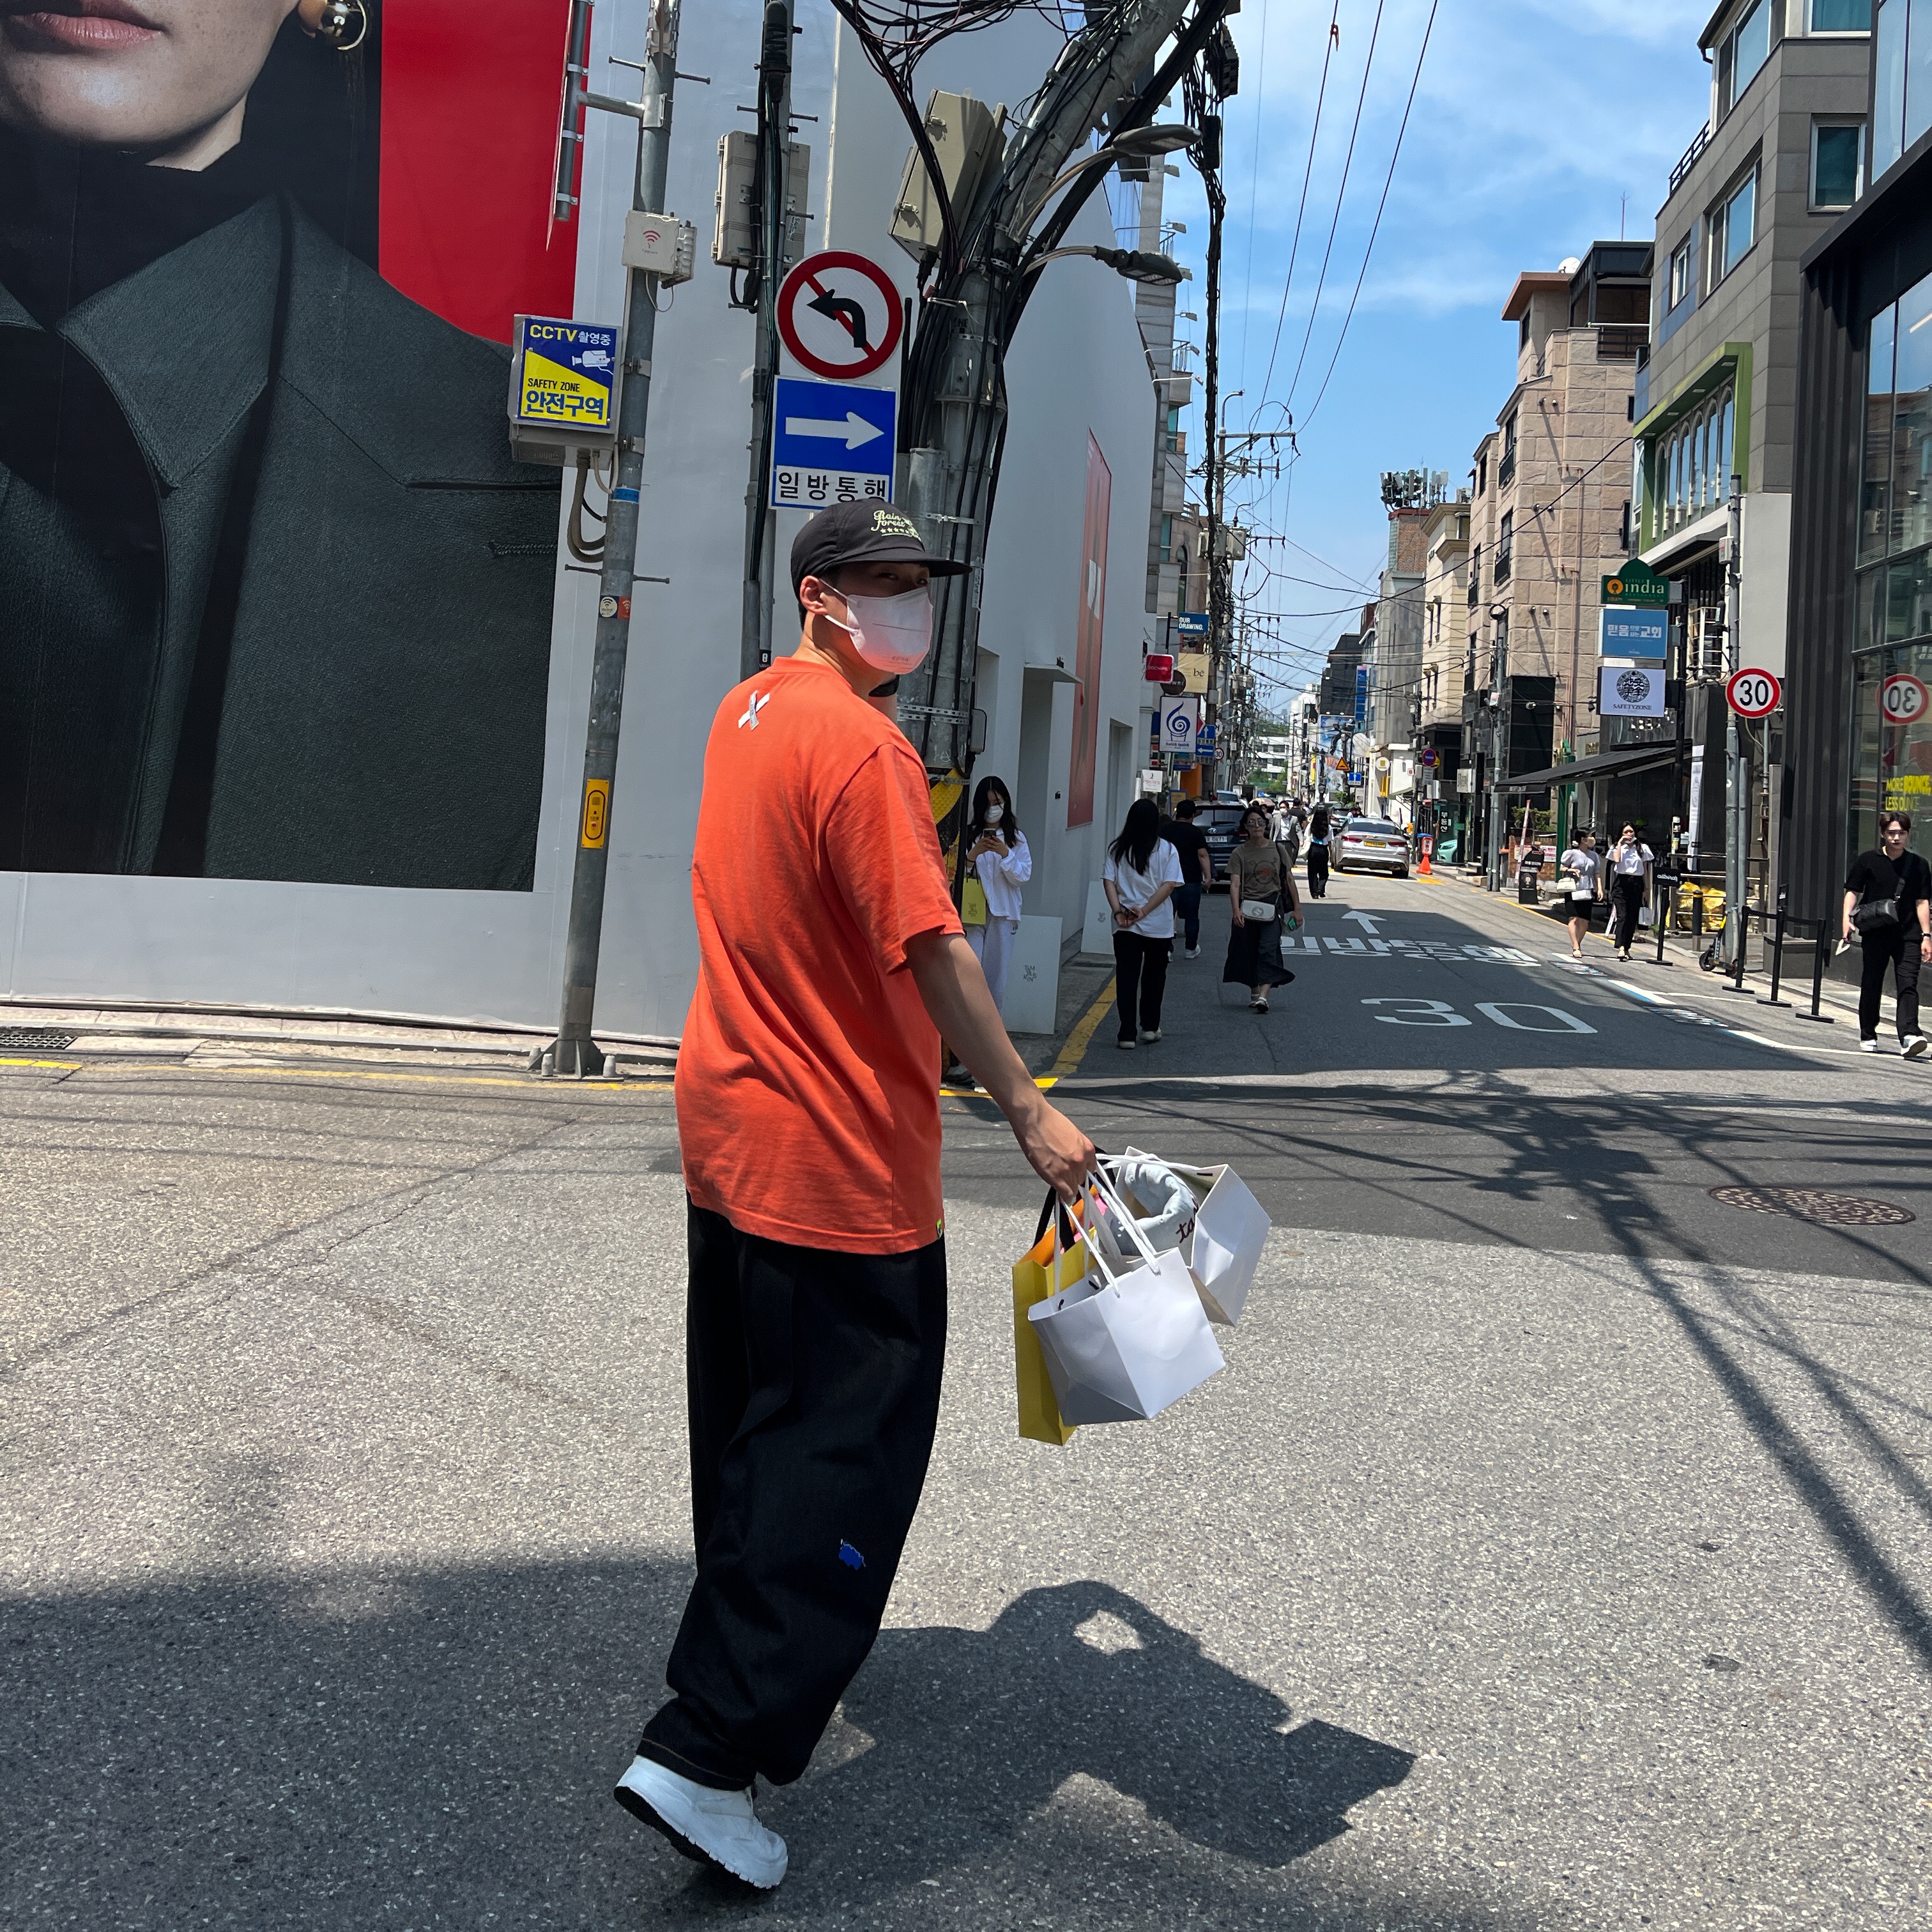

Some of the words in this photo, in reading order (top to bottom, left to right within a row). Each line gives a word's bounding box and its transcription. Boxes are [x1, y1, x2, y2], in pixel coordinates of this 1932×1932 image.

[530, 325, 578, 342] CCTV
[578, 331, 611, 346] 촬영중
[527, 378, 558, 390] SAFETY
[560, 381, 580, 392] ZONE
[526, 390, 604, 420] 안전구역
[778, 472, 886, 503] 일방통행
[1607, 624, 1630, 637] 믿음
[1640, 625, 1662, 638] 교회
[1739, 679, 1769, 707] 30
[1886, 777, 1904, 792] MORE
[1360, 997, 1598, 1034] 30
